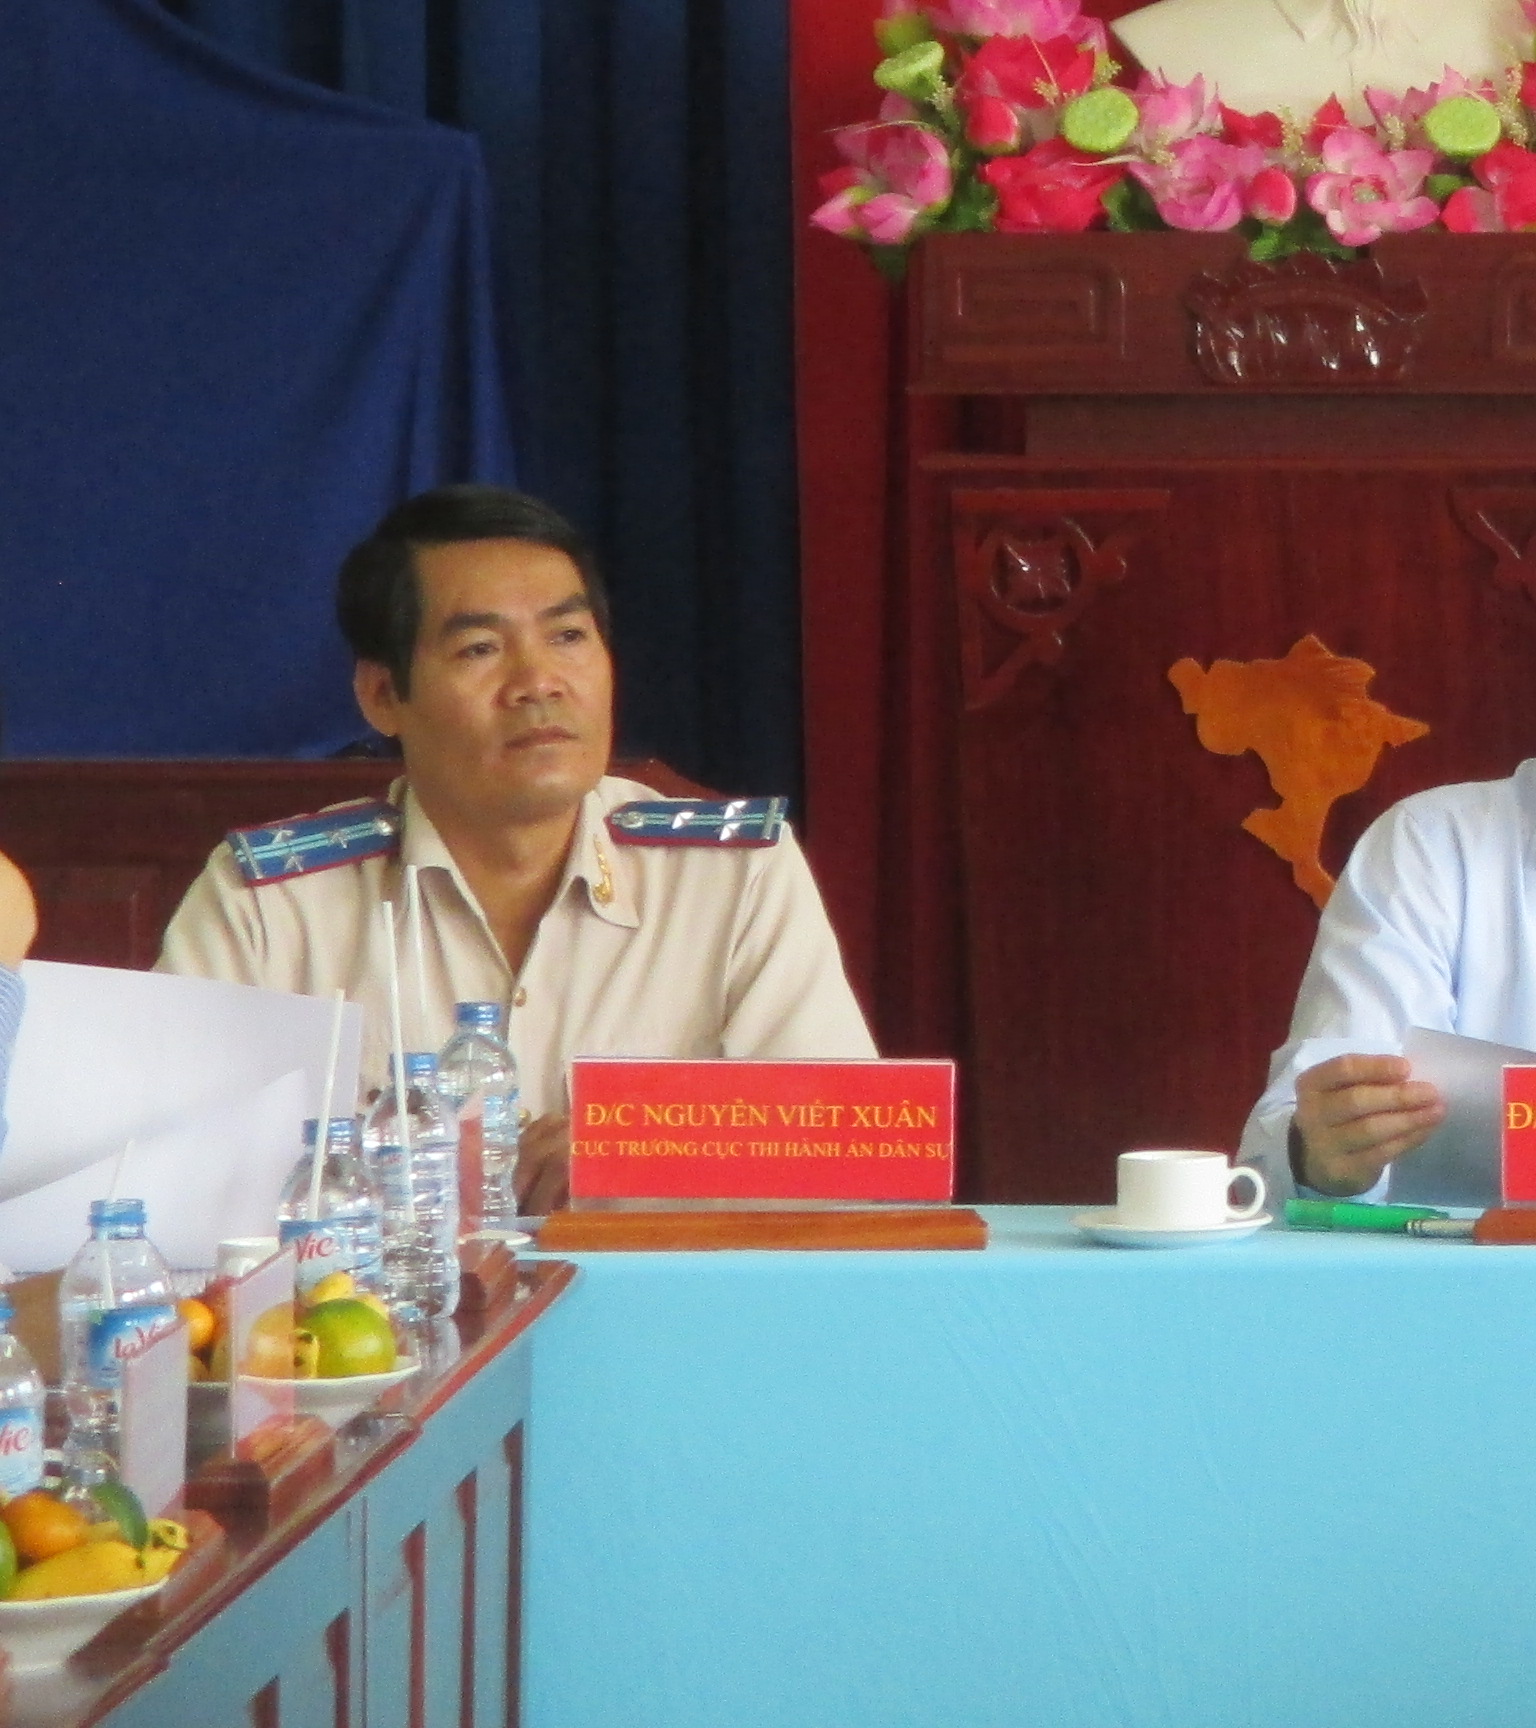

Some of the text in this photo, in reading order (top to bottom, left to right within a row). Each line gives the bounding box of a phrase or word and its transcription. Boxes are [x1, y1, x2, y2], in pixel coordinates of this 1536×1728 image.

[586, 1103, 635, 1126] Đ/C
[851, 1099, 938, 1128] XUÂN
[702, 1141, 743, 1159] CỤC
[748, 1141, 779, 1157] THI
[785, 1138, 841, 1158] HÀNH
